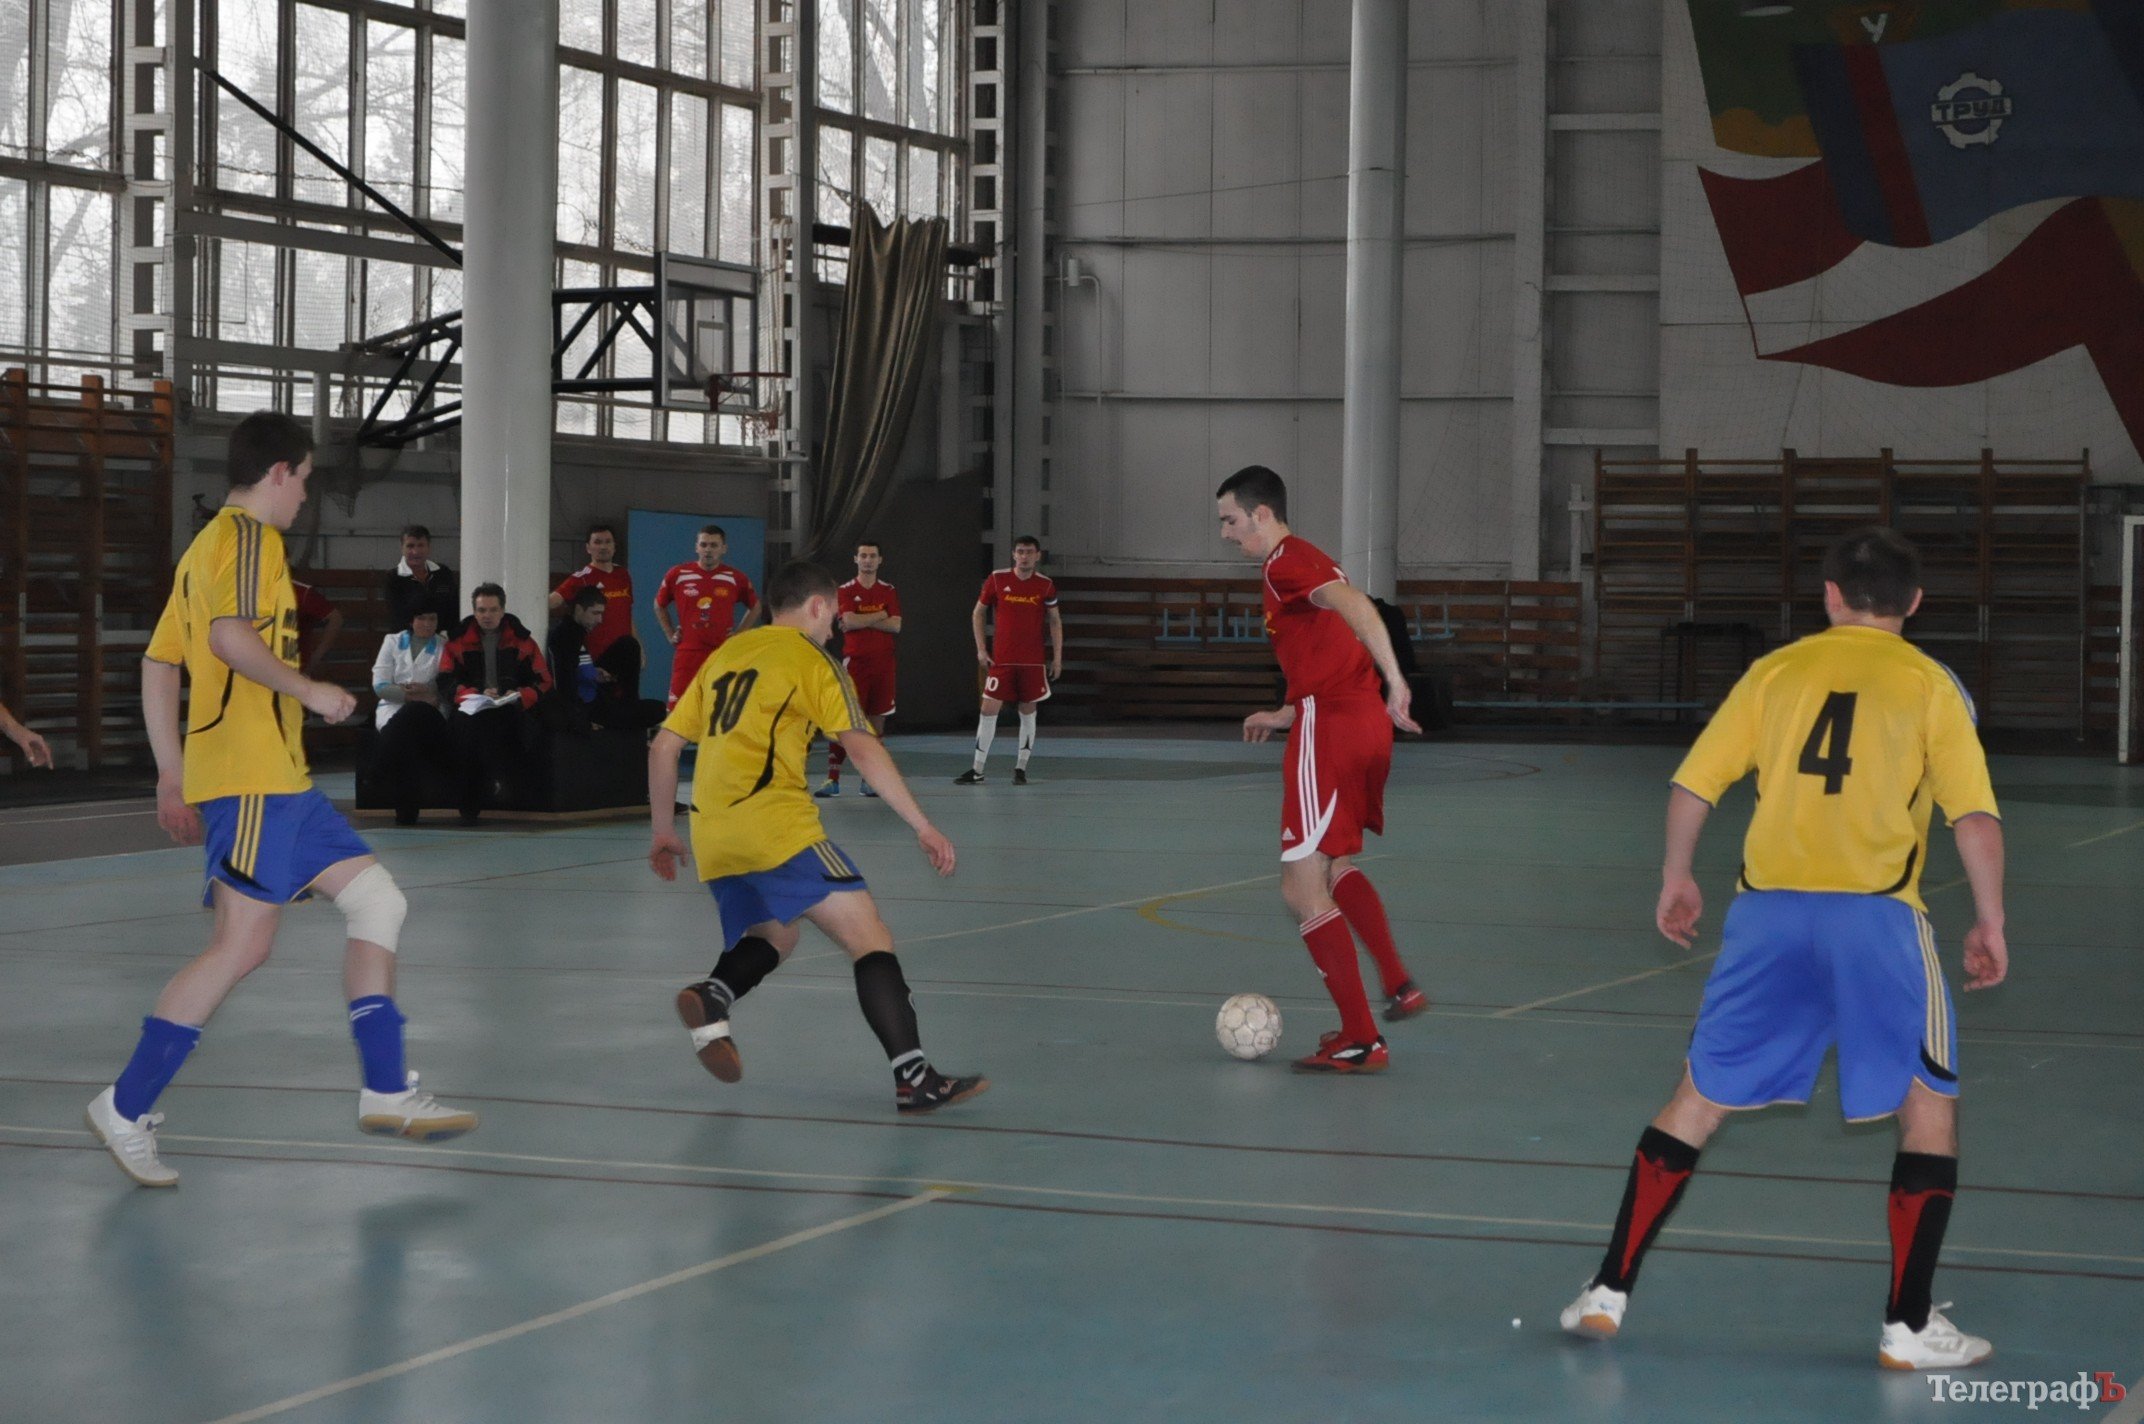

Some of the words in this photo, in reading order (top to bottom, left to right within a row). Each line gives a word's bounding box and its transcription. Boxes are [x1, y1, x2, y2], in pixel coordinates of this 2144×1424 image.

[1934, 97, 2005, 122] ТРУД
[708, 668, 759, 738] 10
[984, 676, 999, 692] 10
[1797, 690, 1858, 796] 4
